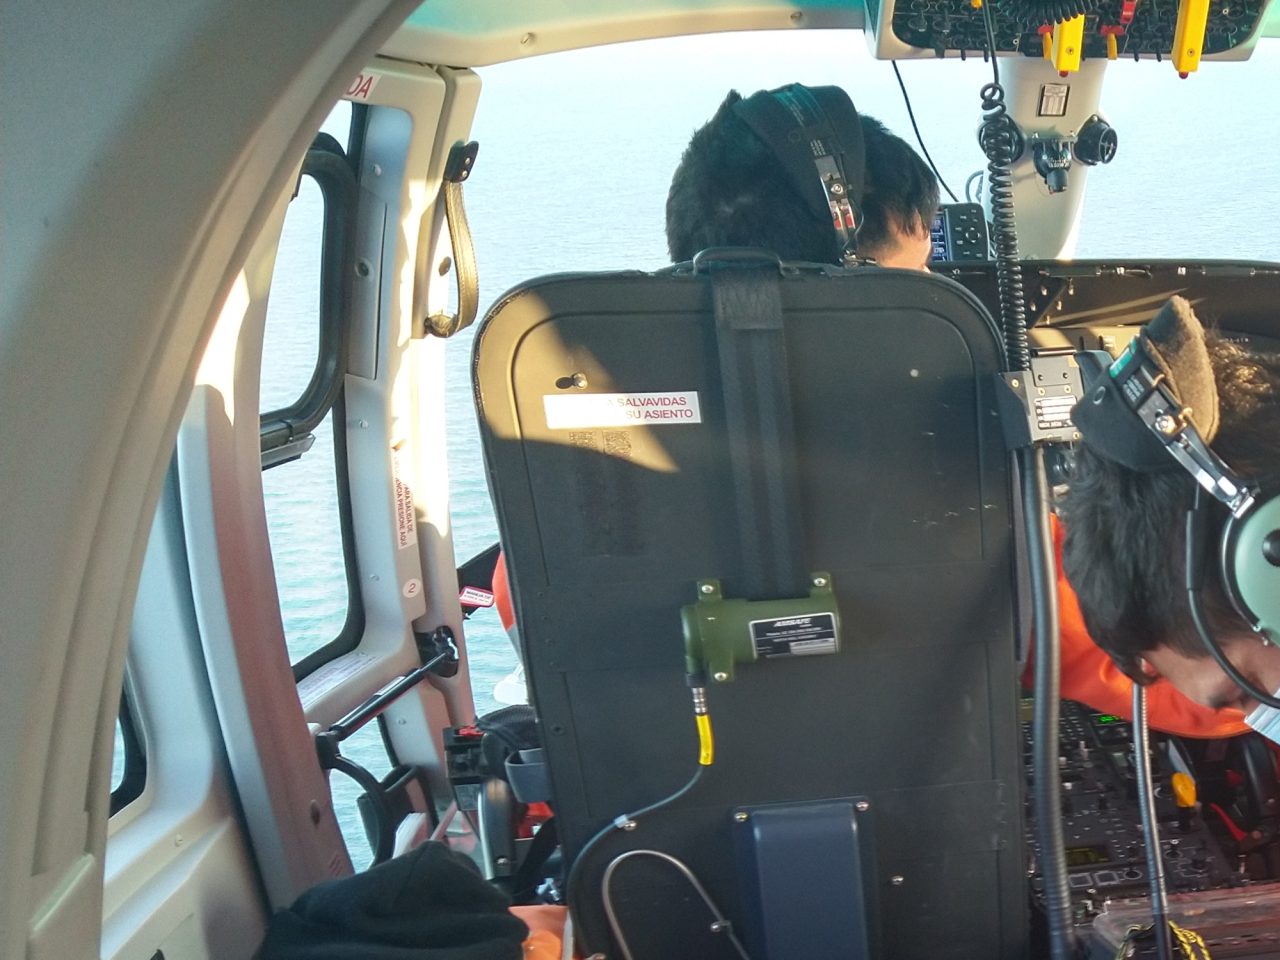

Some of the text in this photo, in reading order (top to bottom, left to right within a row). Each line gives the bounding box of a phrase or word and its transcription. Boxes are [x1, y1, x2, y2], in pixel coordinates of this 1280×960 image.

[617, 396, 687, 407] SALVAVIDAS
[644, 409, 693, 419] ASIENTO
[408, 583, 416, 594] 2
